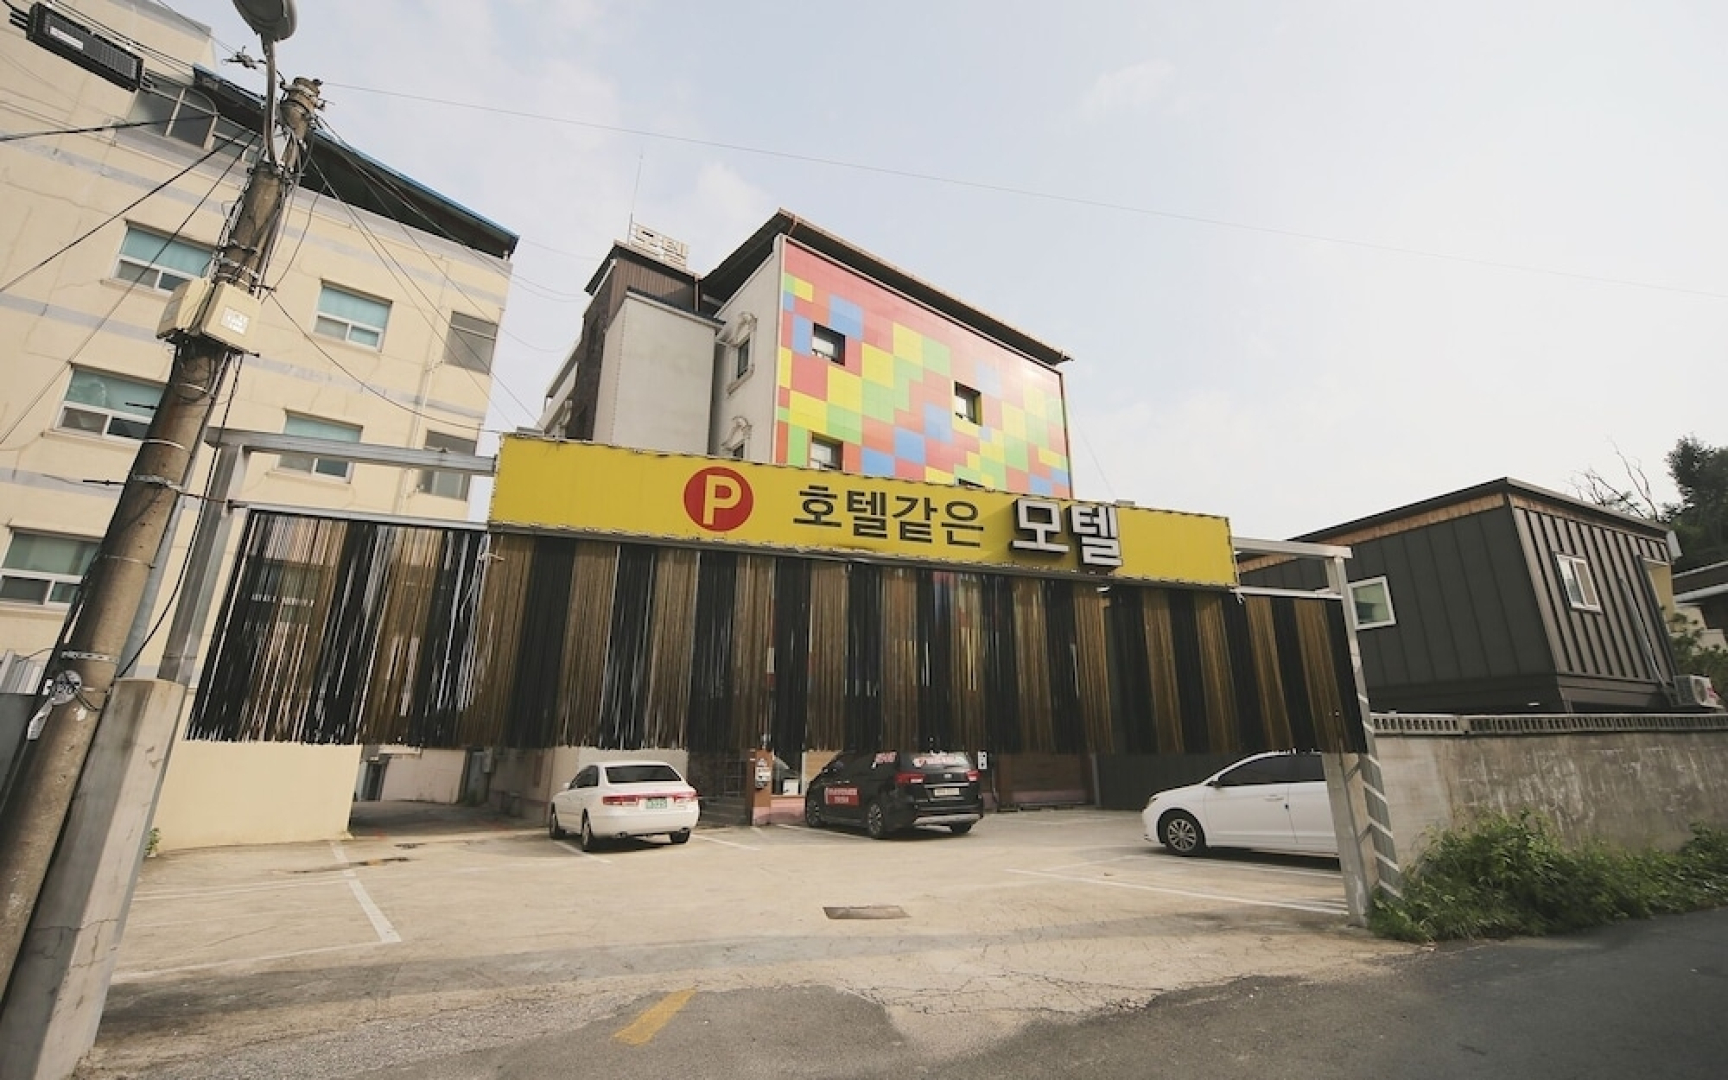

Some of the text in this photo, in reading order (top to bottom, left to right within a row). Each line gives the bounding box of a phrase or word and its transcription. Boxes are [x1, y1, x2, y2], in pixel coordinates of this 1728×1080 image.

[631, 223, 688, 269] 모텔
[703, 474, 742, 525] P
[793, 484, 1123, 569] 호텔같은 모텔
